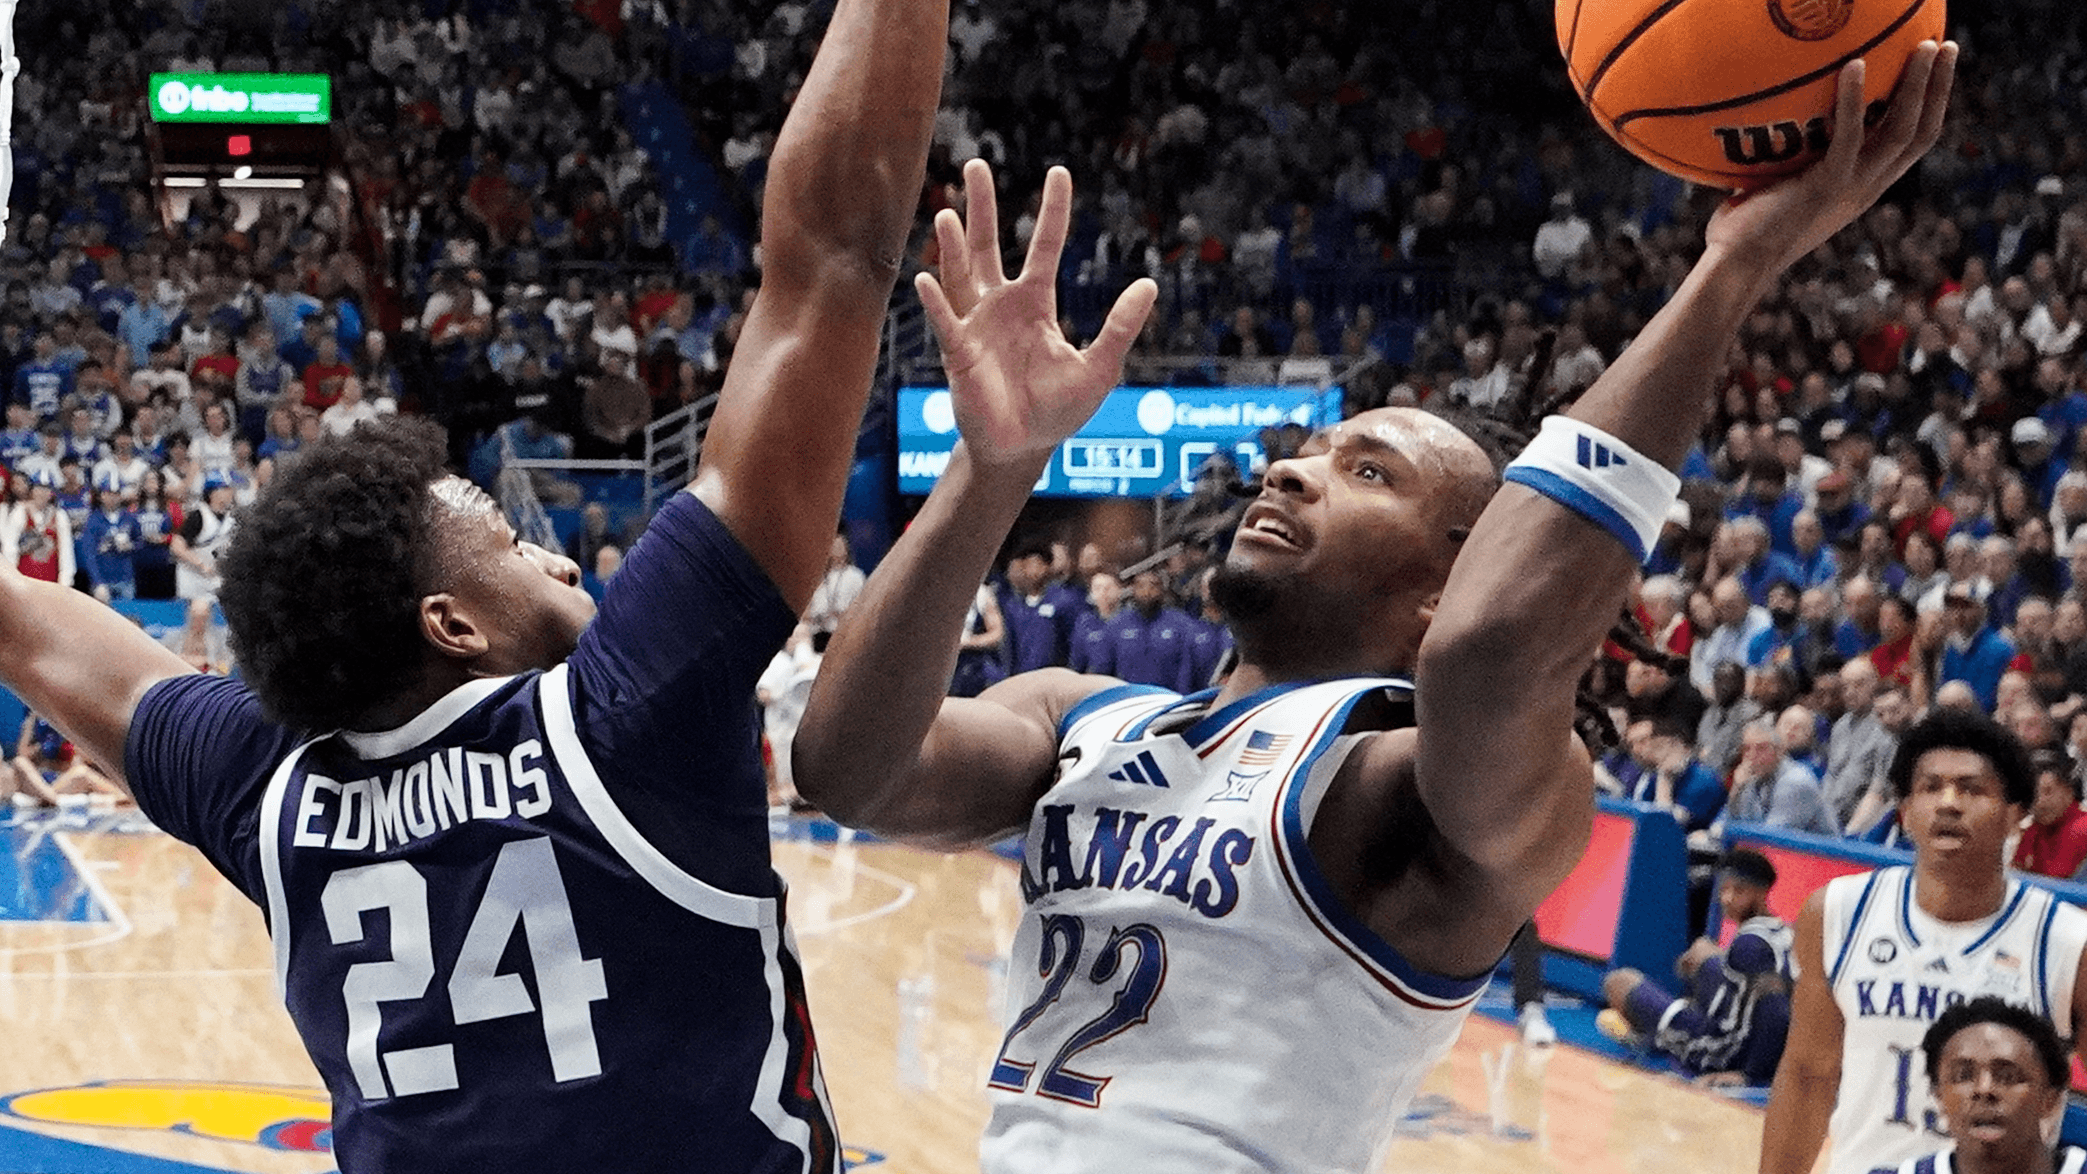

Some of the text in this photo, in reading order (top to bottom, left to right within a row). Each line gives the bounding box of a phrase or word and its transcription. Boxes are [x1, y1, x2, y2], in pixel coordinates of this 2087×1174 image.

[293, 738, 552, 853] EDMONDS
[320, 835, 609, 1101] 24
[987, 912, 1168, 1109] 22
[1856, 979, 1966, 1020] KAN
